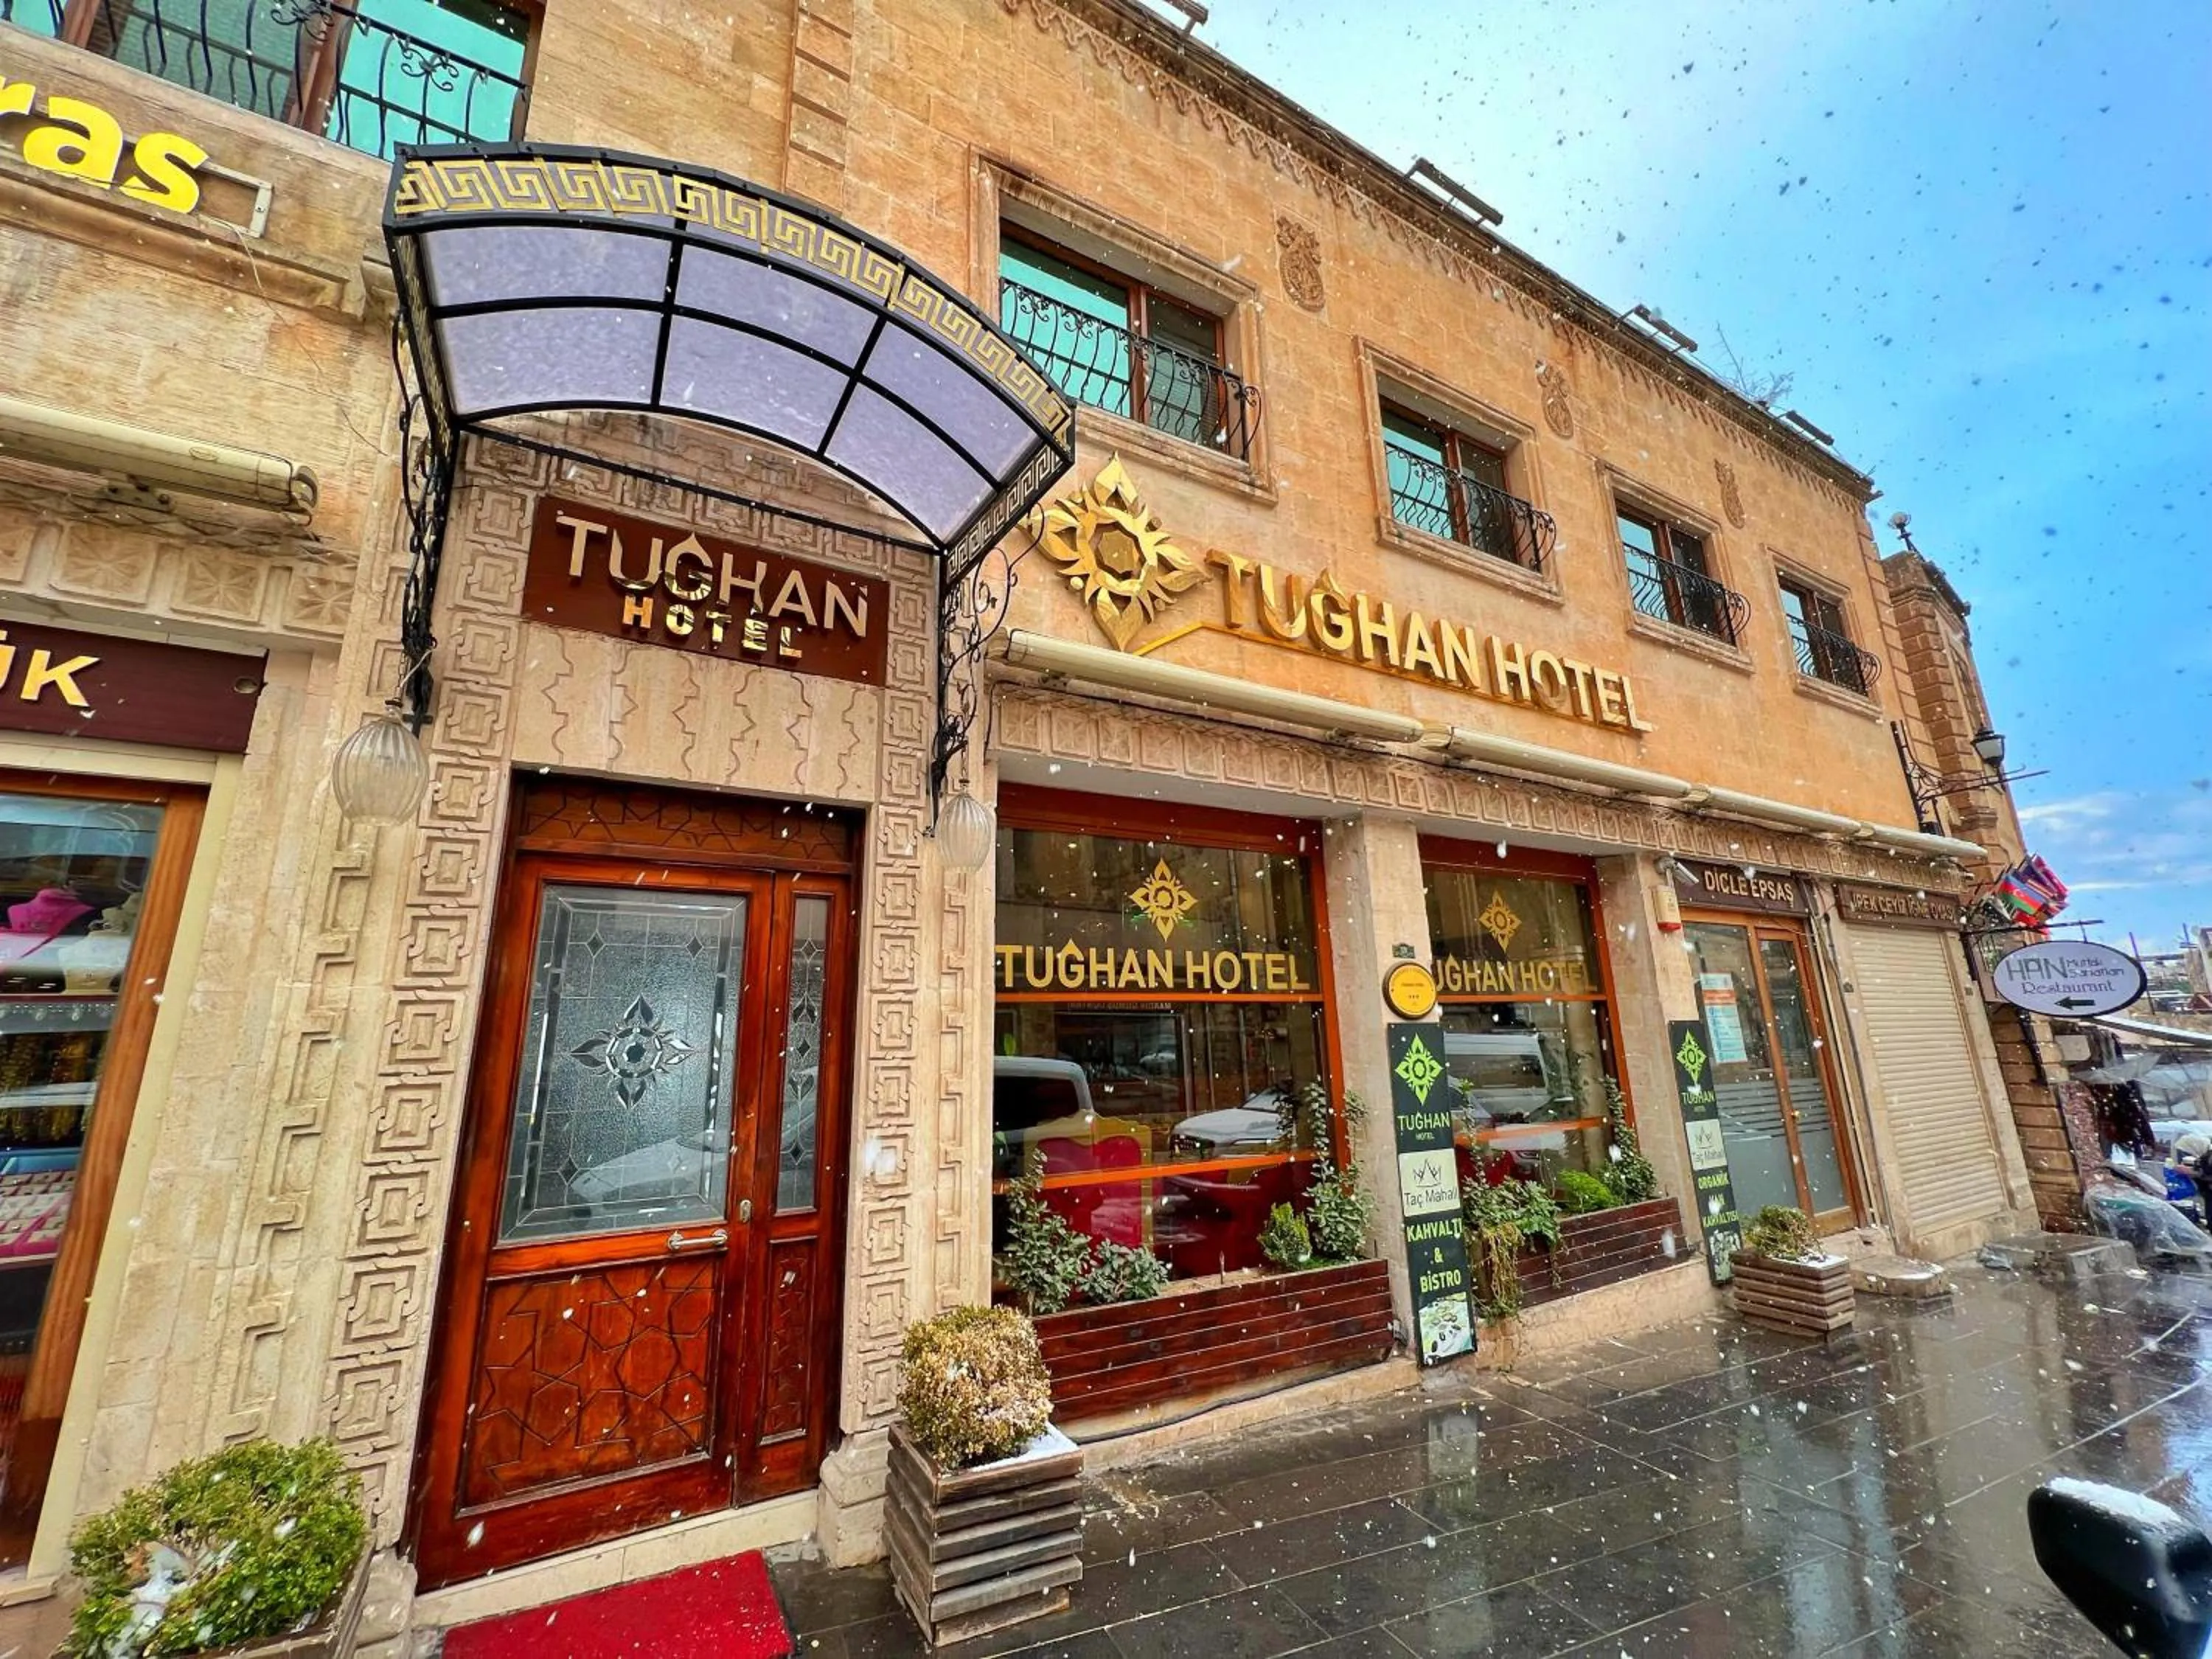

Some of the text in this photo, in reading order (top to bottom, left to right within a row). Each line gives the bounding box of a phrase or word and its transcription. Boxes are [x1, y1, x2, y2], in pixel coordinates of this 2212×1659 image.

[622, 595, 803, 658] HOTEL
[1488, 634, 1653, 733] HOTEL
[1186, 950, 1310, 990] HOTEL
[1520, 960, 1598, 993] HOTEL
[2005, 956, 2068, 981] HAN
[1415, 1131, 1435, 1141] HOTEL
[1404, 1192, 1422, 1208] Taç
[1407, 1217, 1463, 1242] KAHVALTI
[1434, 1247, 1444, 1263] &
[1419, 1268, 1461, 1293] BİSTRO
